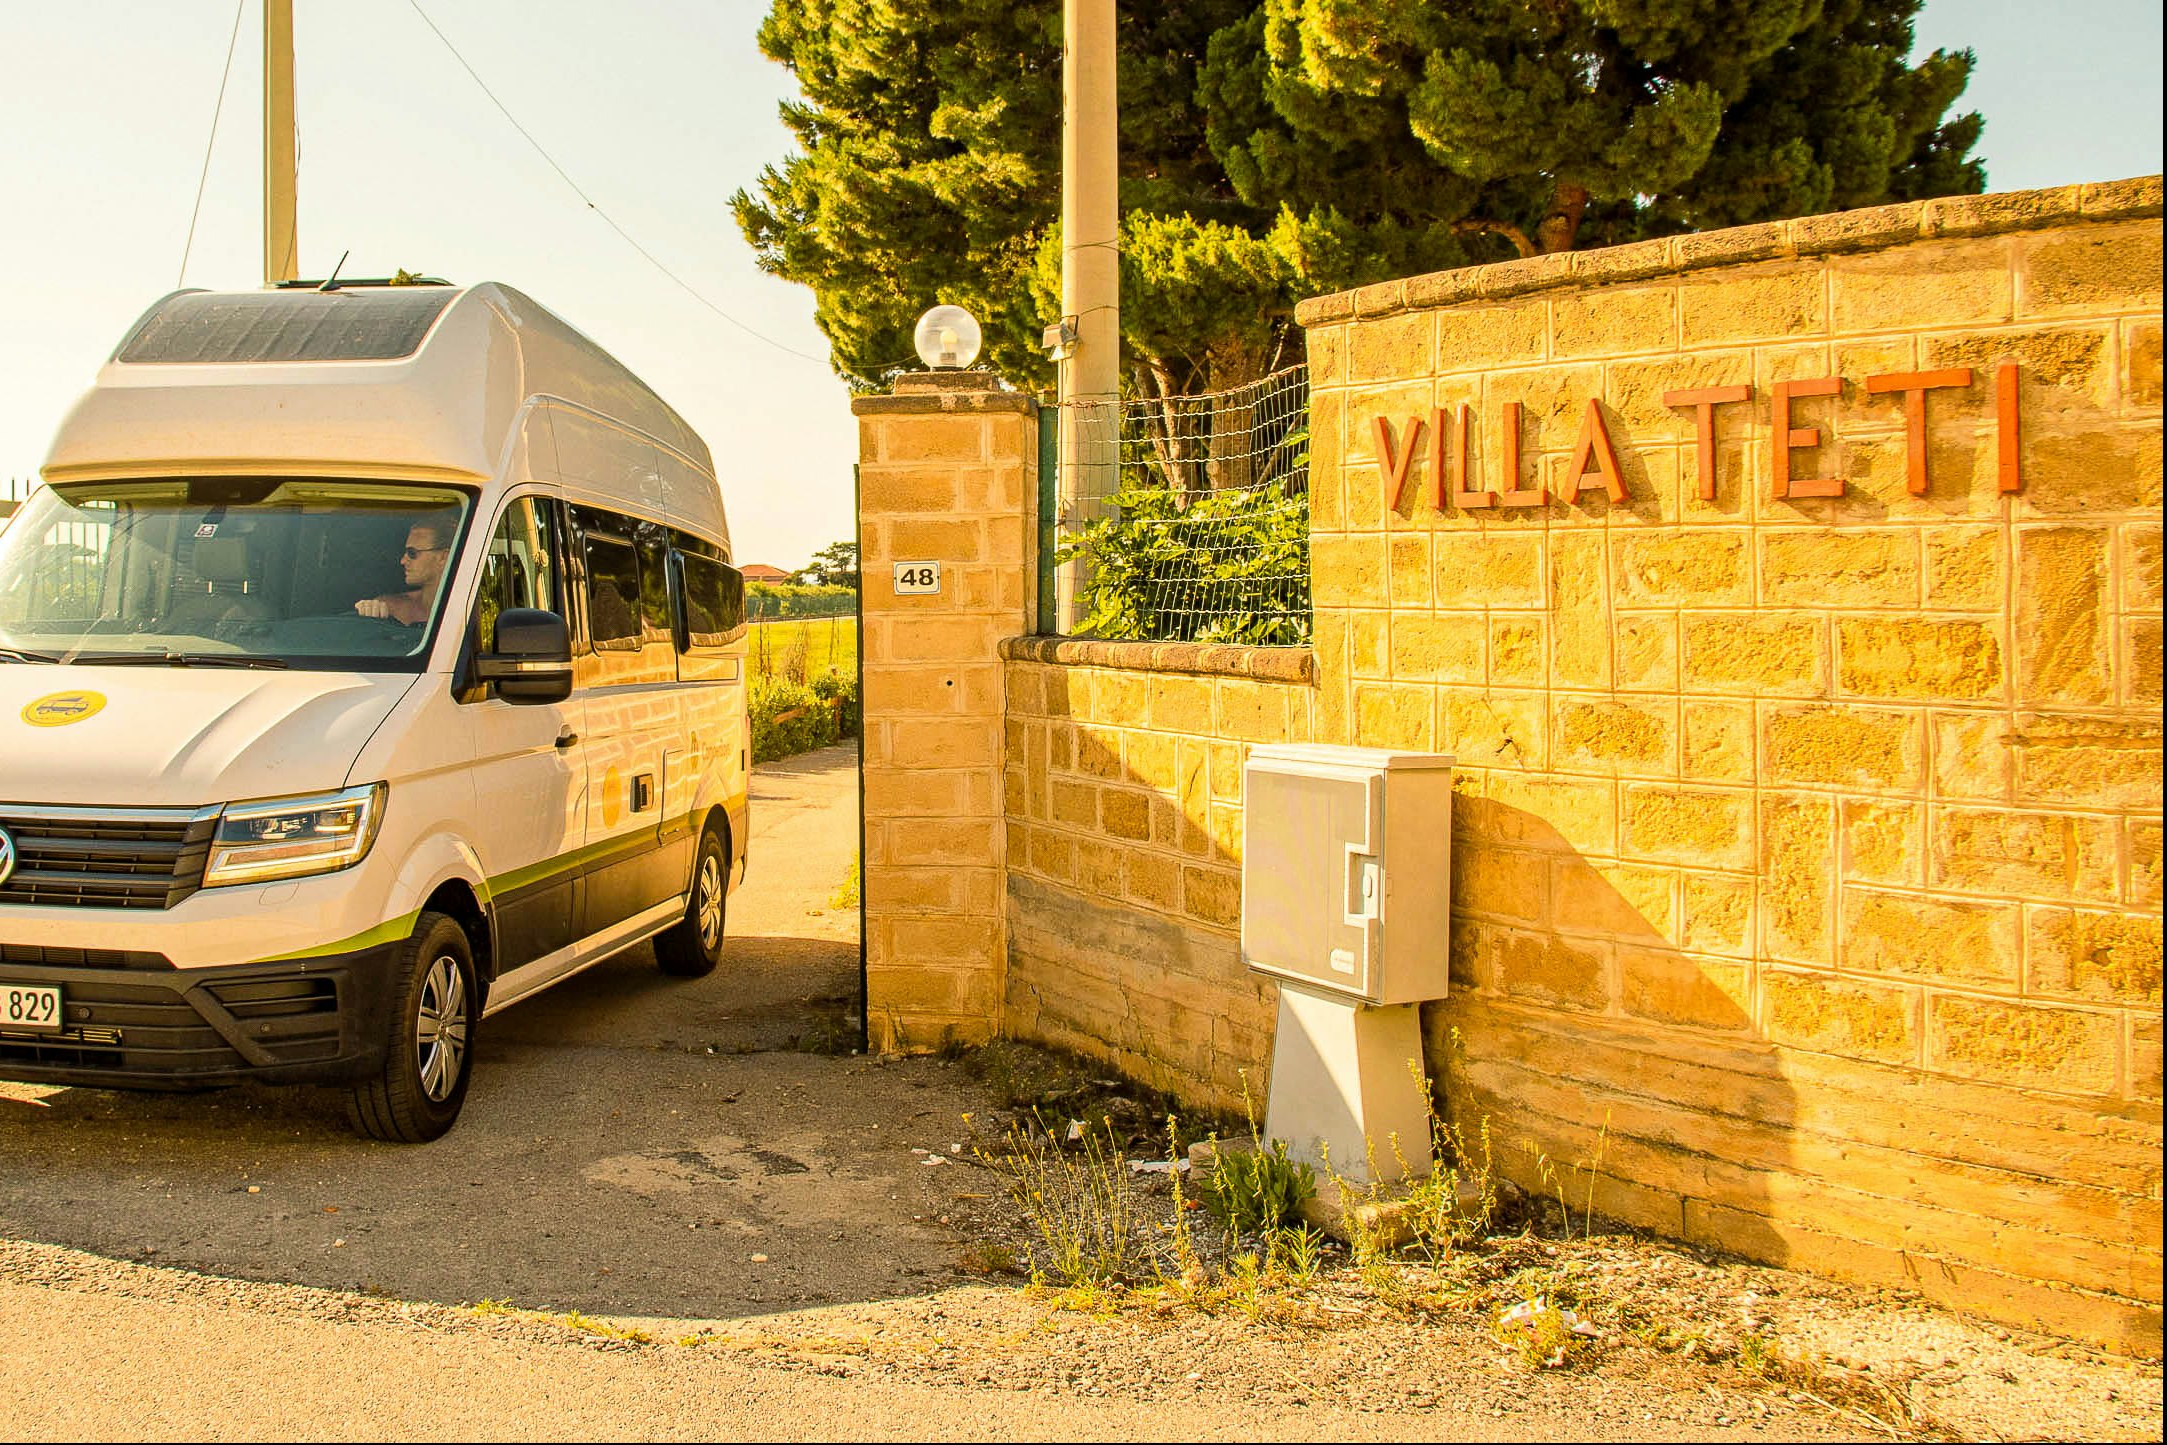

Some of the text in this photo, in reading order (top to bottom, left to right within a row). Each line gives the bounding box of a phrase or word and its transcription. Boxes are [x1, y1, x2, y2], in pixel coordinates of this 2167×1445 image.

[1371, 364, 2020, 511] VILLA TETI
[900, 568, 934, 586] 48
[9, 990, 55, 1022] 829
